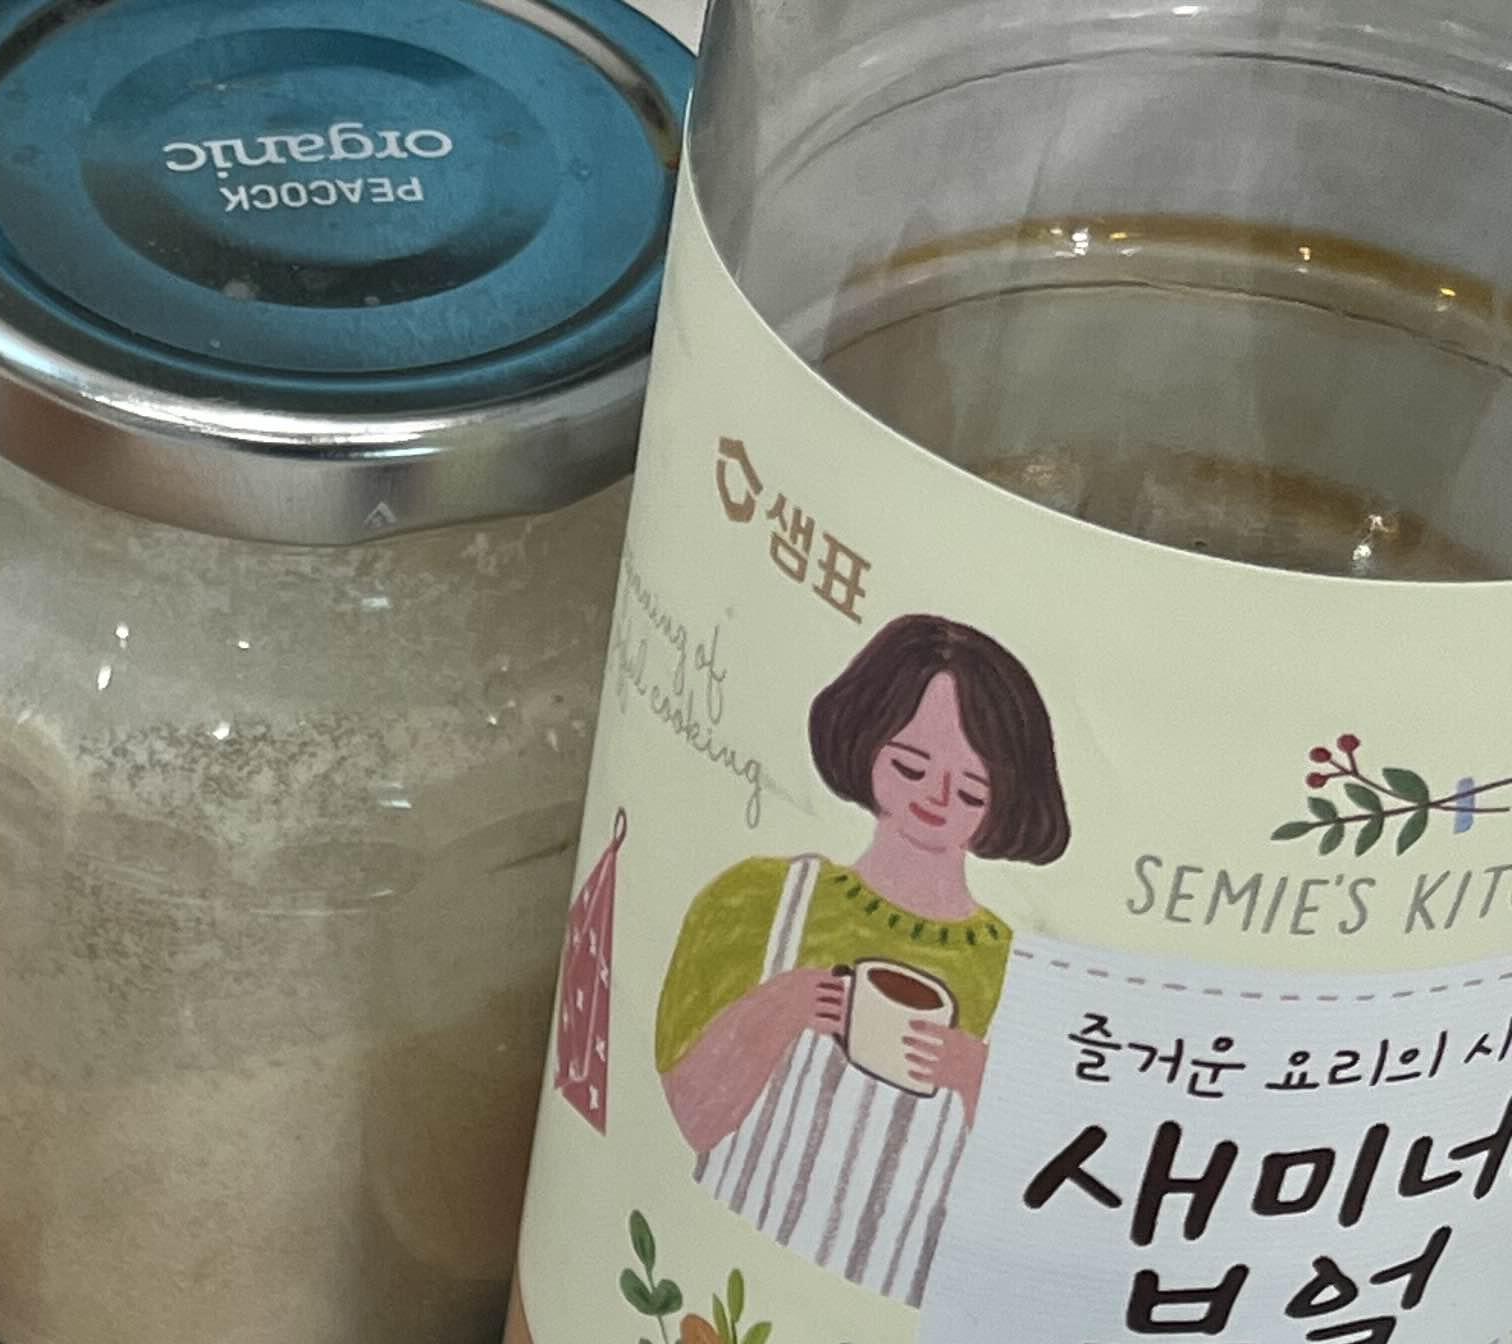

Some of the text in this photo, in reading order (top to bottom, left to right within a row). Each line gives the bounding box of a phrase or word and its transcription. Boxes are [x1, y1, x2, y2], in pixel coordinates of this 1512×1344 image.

[164, 123, 453, 176] organic
[221, 176, 423, 212] PEACOCK
[767, 493, 871, 624] 샘표
[694, 624, 727, 725] of
[650, 685, 762, 829] cooking
[1126, 855, 1376, 935] SEMIE'S
[1068, 1012, 1245, 1098] 즐거운
[1265, 1030, 1448, 1090] 요리의
